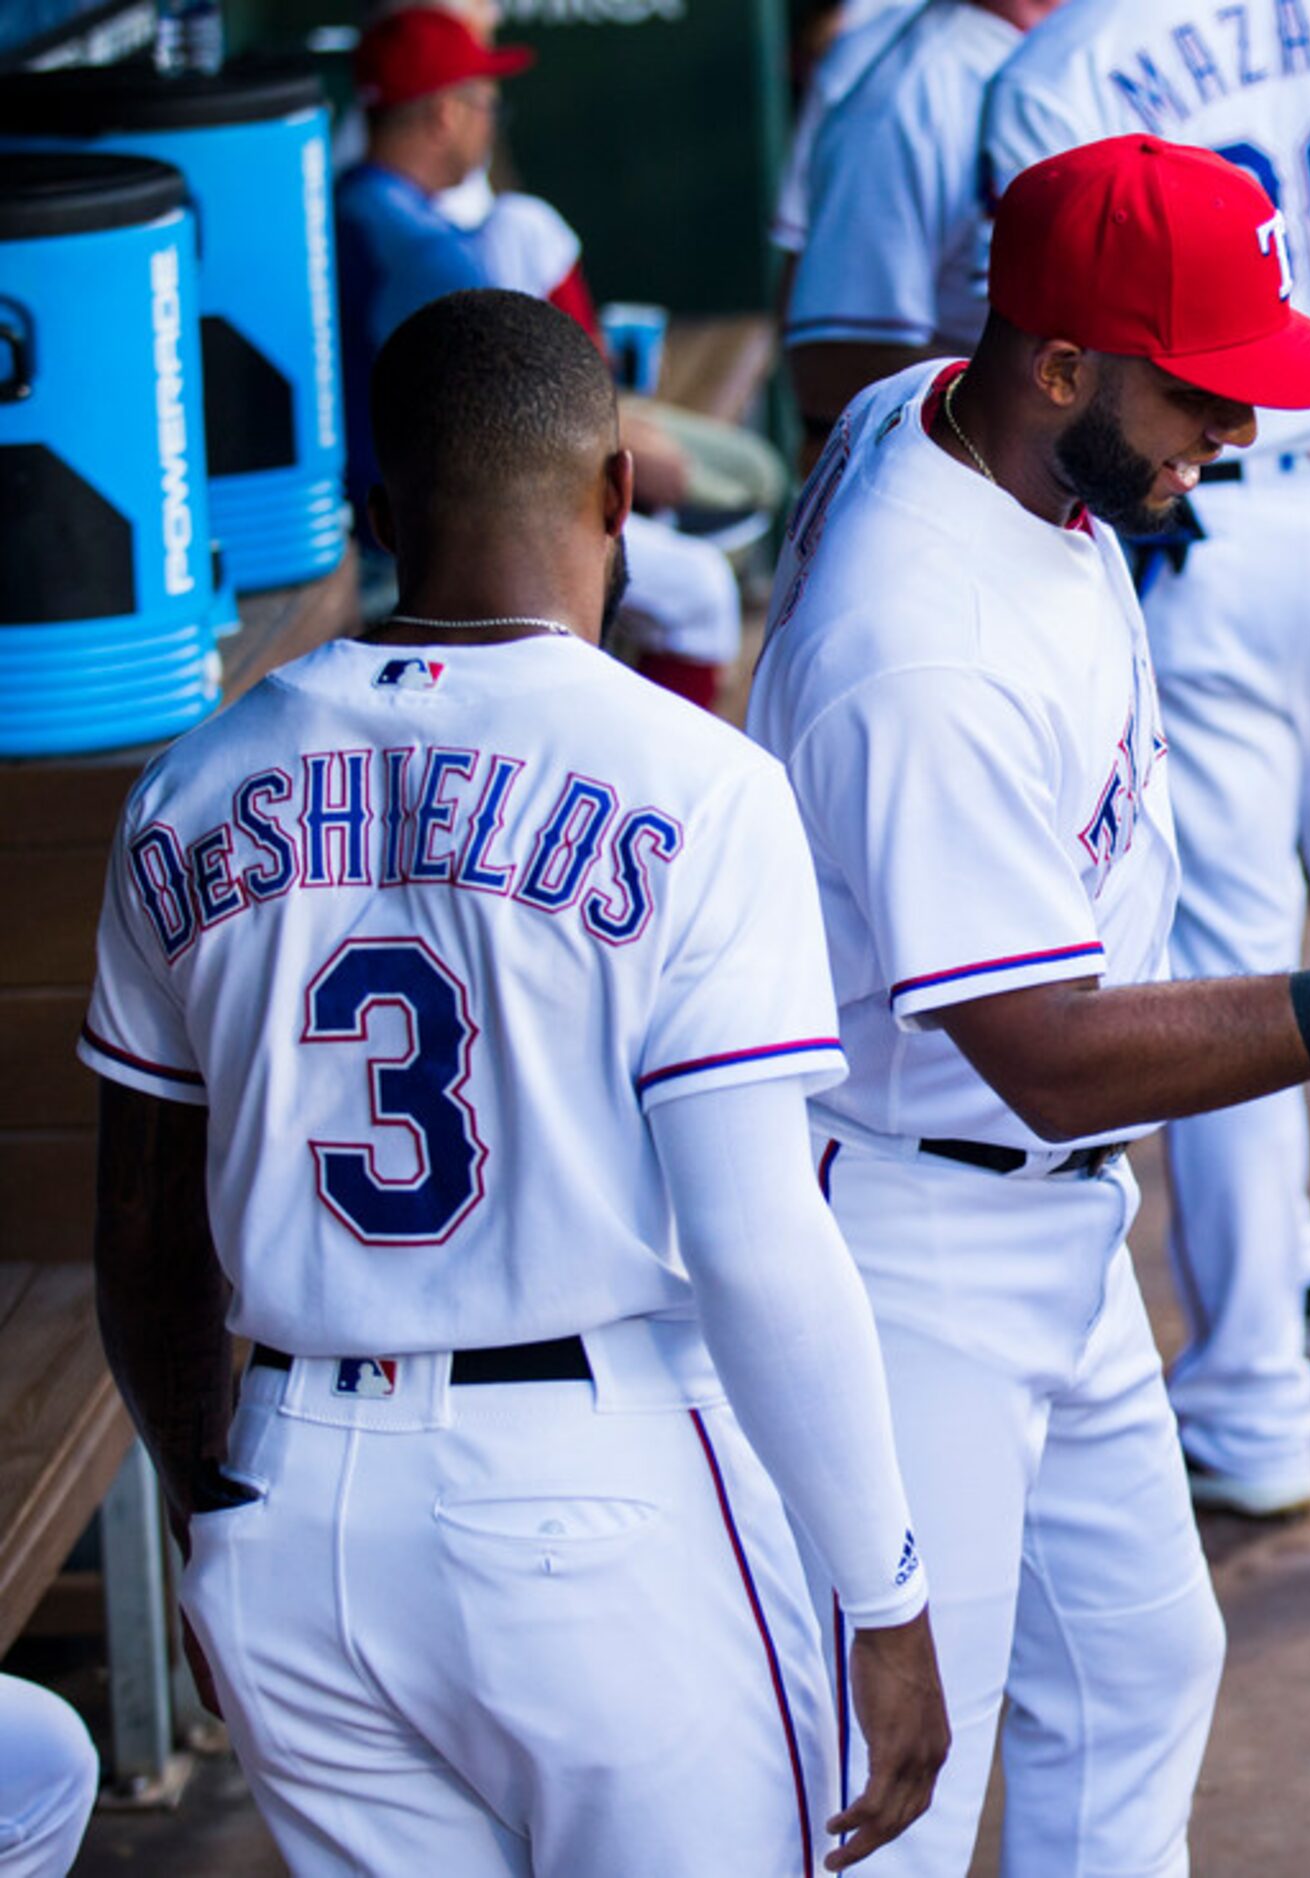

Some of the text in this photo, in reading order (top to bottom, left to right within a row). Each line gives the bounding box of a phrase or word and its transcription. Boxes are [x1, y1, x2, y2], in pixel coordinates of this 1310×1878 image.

[1255, 207, 1296, 302] T
[150, 243, 195, 597] POWERADE
[300, 937, 489, 1246] 3
